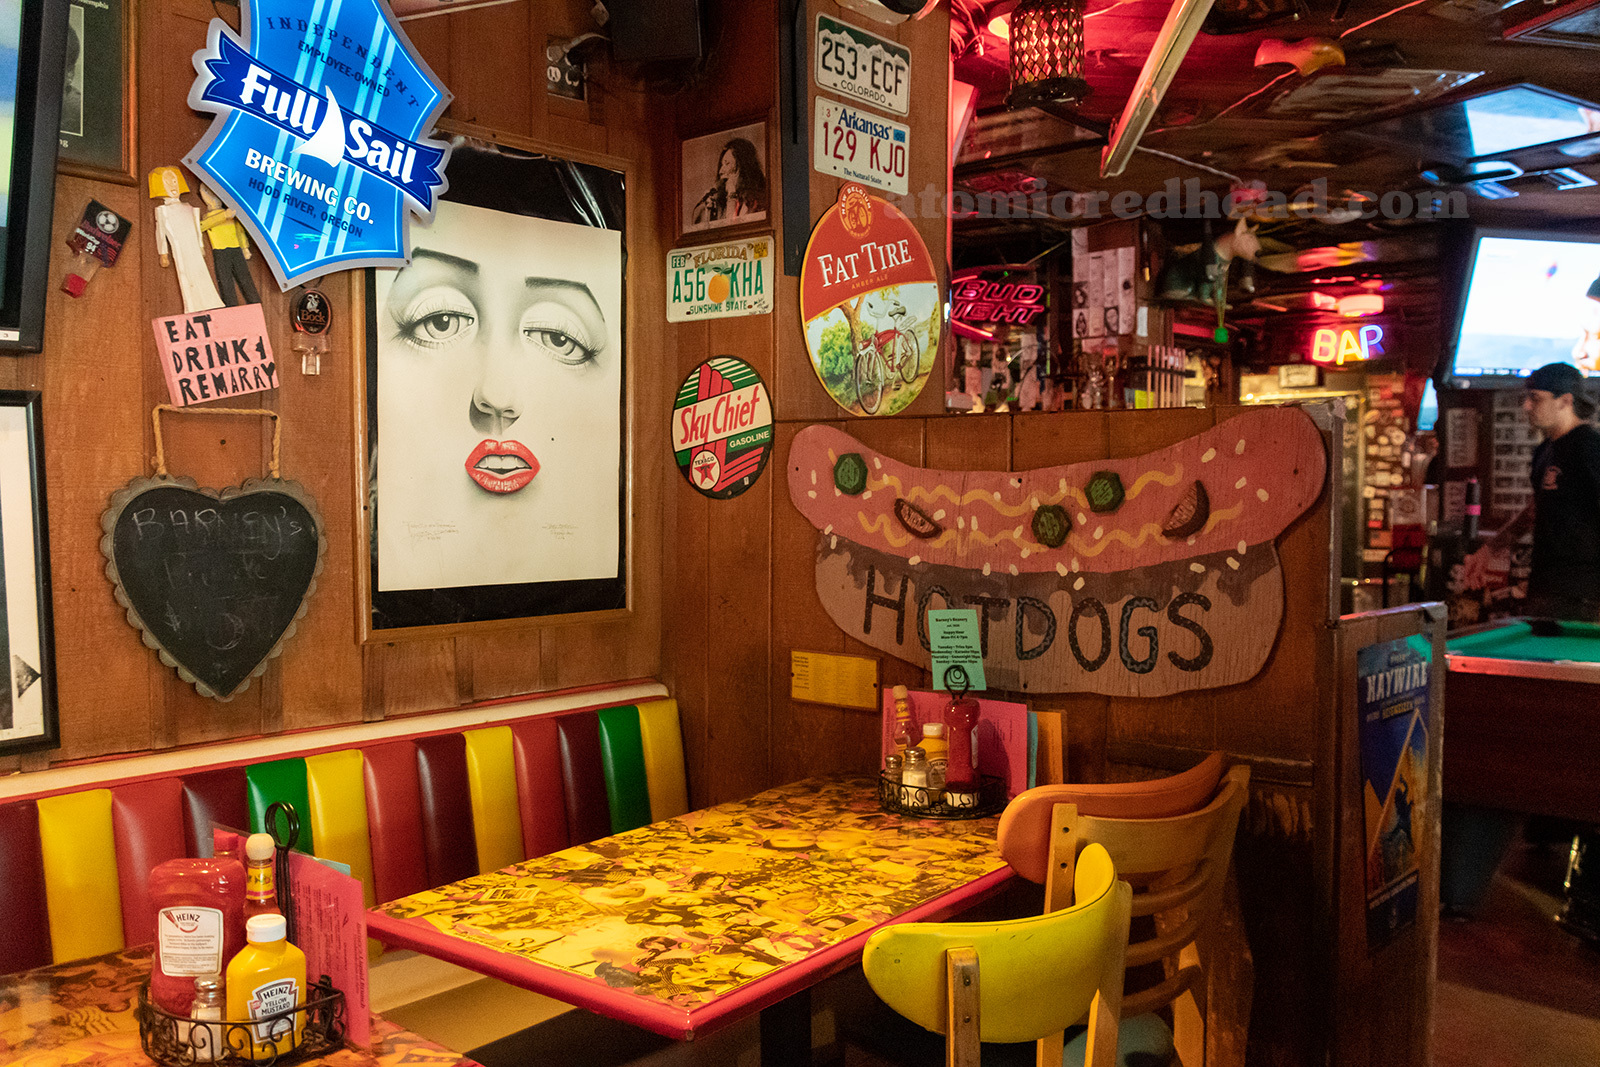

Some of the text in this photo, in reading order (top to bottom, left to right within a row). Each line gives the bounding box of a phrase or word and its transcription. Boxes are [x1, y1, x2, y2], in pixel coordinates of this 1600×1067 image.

[266, 16, 419, 108] INDEPENDENT
[297, 40, 390, 98] EMPLOYEE-OWNED
[840, 79, 887, 104] COLORADO
[239, 63, 417, 184] Full Sail
[838, 108, 890, 140] Arkansas
[823, 121, 857, 162] 129
[244, 147, 374, 225] BREWING CO.
[847, 186, 871, 209] BELGIUM
[248, 176, 363, 238] HOOD RIVER, OREGON
[673, 256, 685, 268] FEB
[693, 245, 748, 269] FLORIDA
[730, 260, 763, 298] KHA
[851, 274, 888, 289] AMBER ALE
[954, 279, 1044, 304] BUD
[690, 302, 722, 314] SUNSHINE
[726, 300, 747, 312] STATE
[951, 301, 1045, 324] IGHT
[164, 314, 212, 343] EAT
[172, 338, 251, 374] DRINK
[1312, 324, 1385, 365] BAR
[178, 361, 275, 406] REMARRY
[680, 385, 760, 444] Sky Chief
[729, 430, 770, 448] GASOLINE
[694, 456, 714, 466] TEXACO
[1366, 661, 1427, 703] HAYWIRE
[176, 913, 200, 922] HEINZ
[262, 986, 289, 999] HEINZ
[264, 997, 287, 1008] YELLOW
[261, 1001, 290, 1015] MUSTARD
